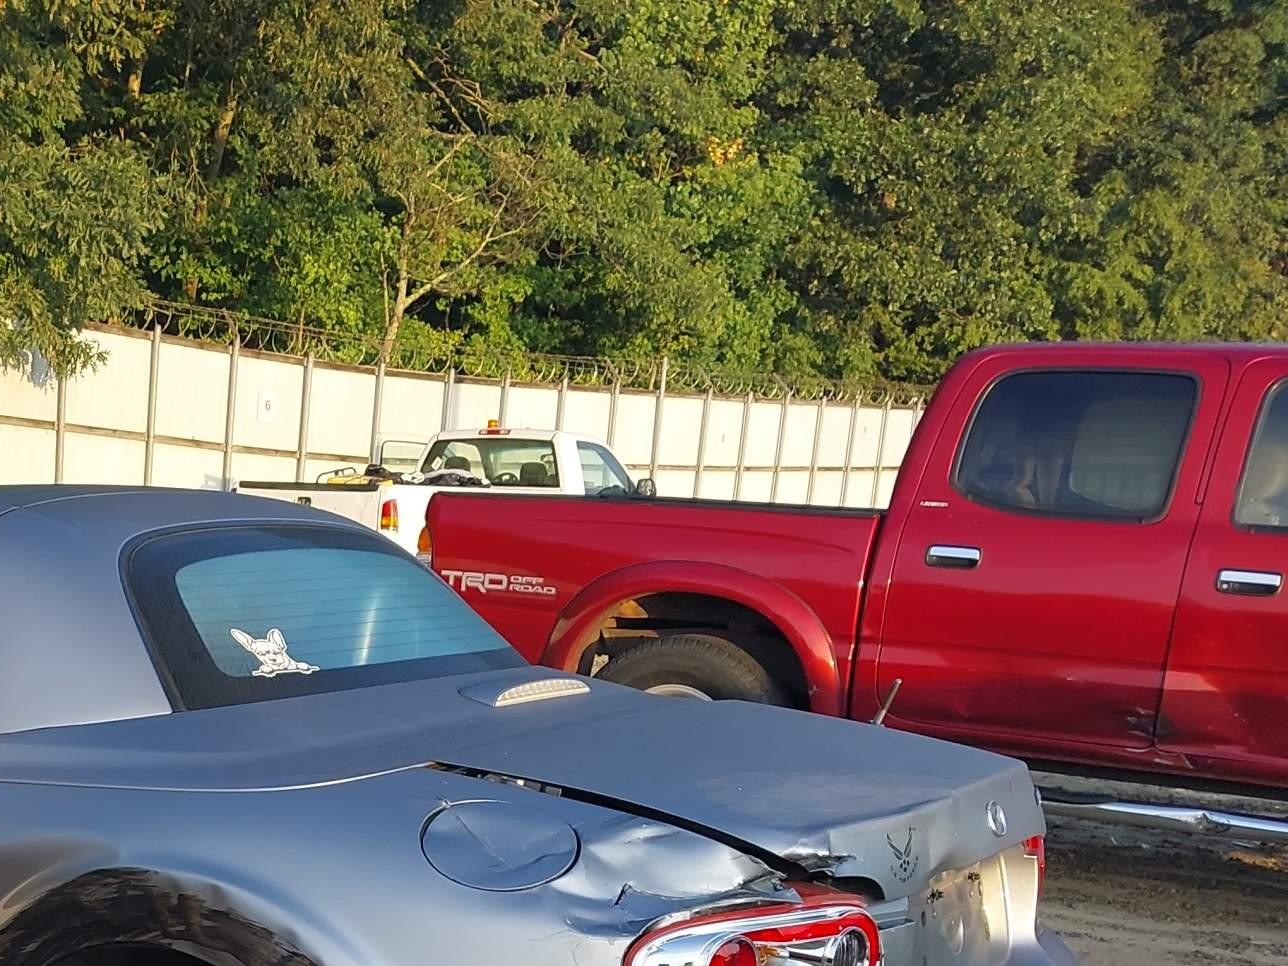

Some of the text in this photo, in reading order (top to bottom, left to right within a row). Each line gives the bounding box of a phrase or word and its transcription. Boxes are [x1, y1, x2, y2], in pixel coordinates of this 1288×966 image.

[265, 399, 271, 412] 6
[440, 569, 508, 594] TRD
[509, 575, 545, 584] OFF
[508, 584, 557, 595] ROAD
